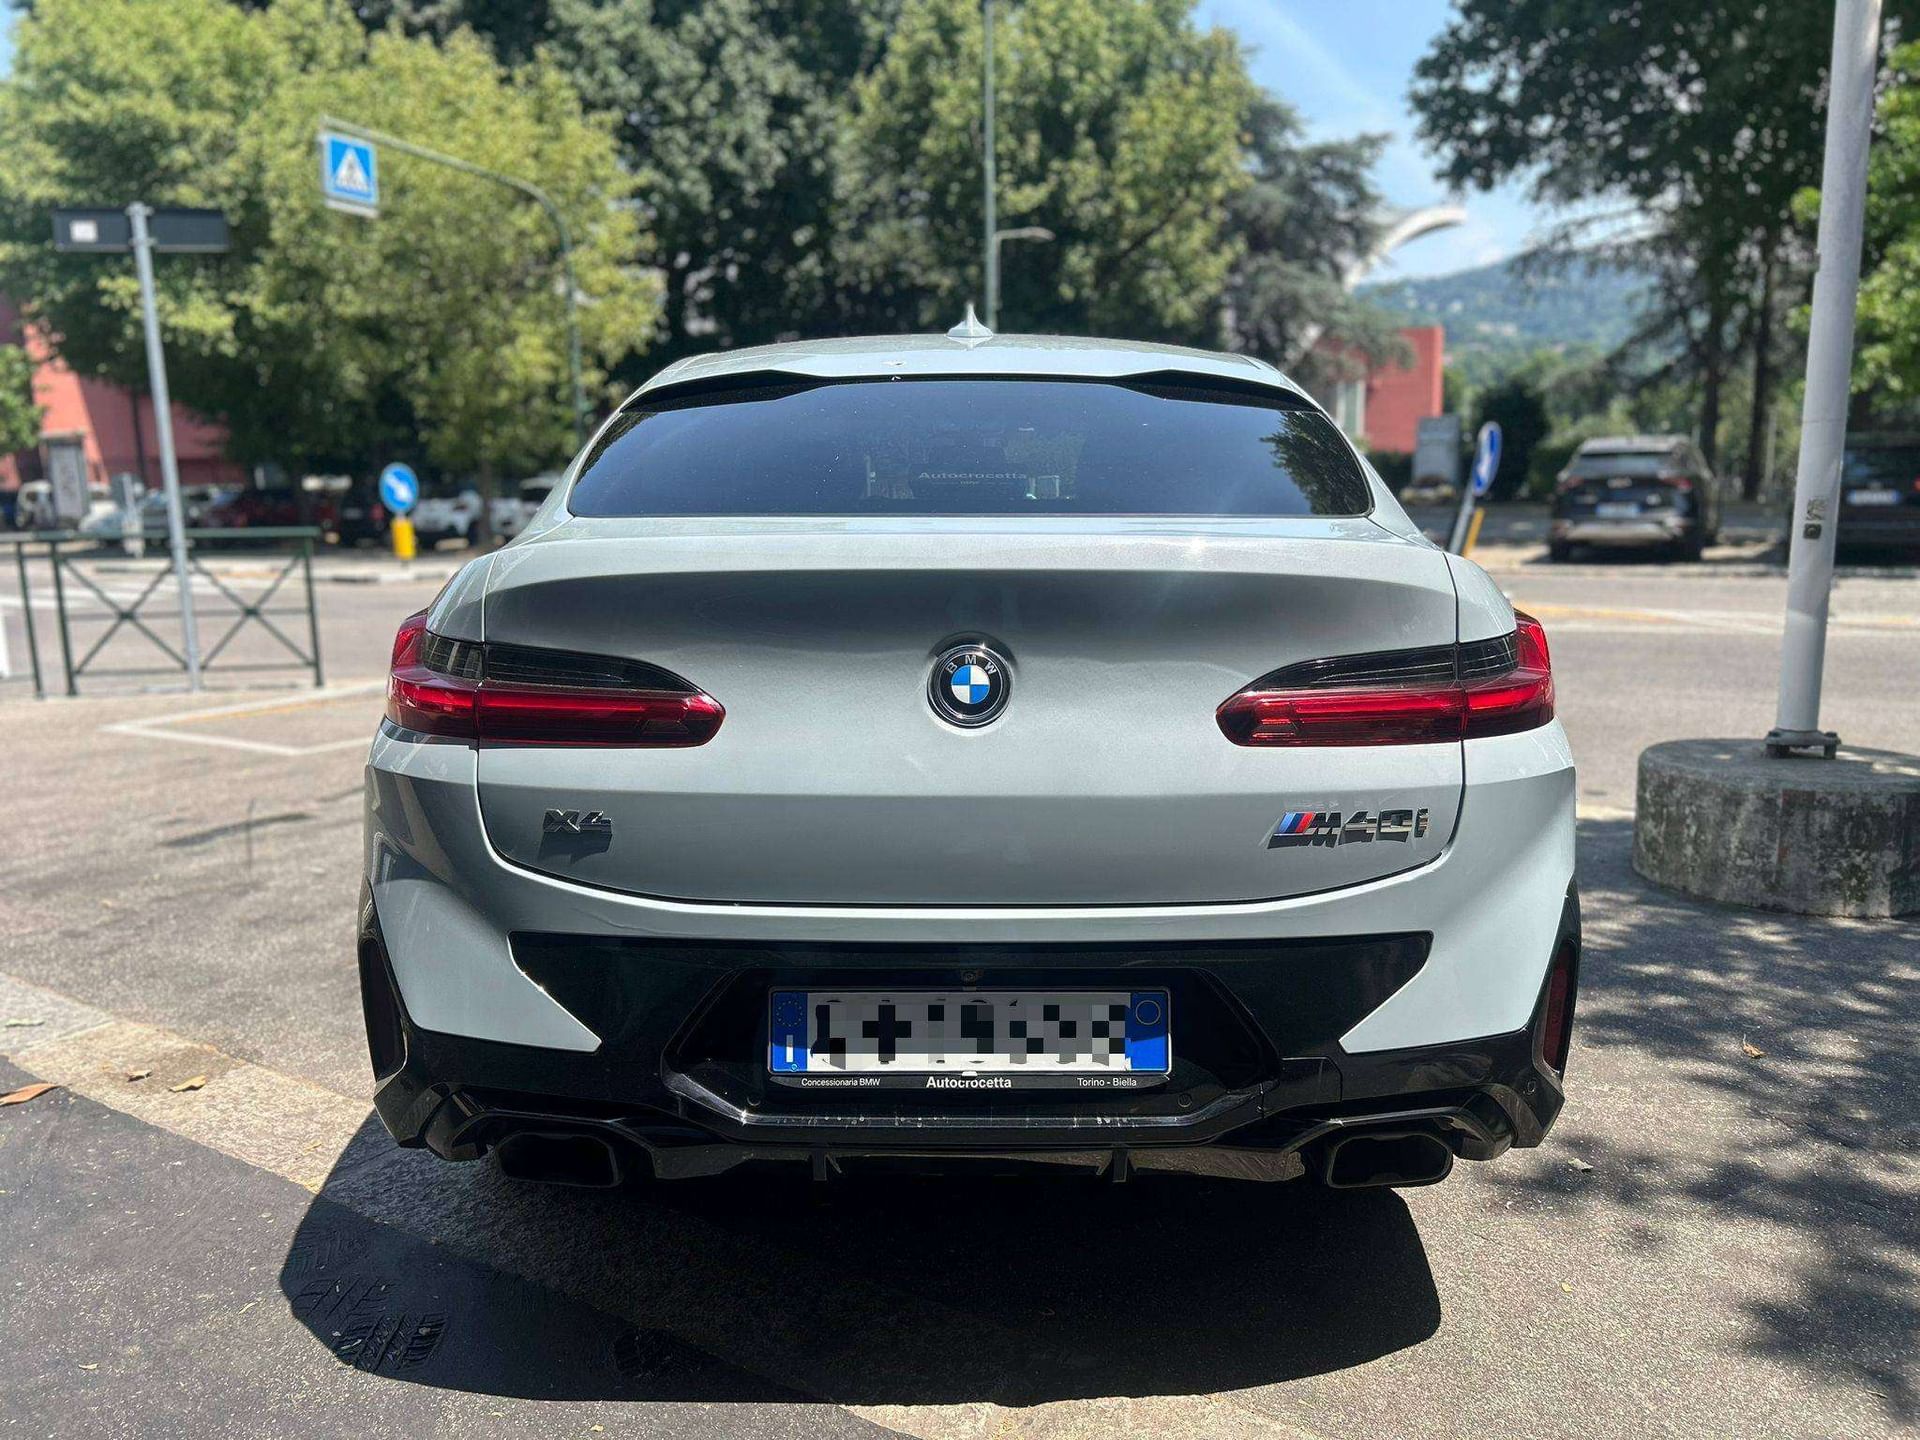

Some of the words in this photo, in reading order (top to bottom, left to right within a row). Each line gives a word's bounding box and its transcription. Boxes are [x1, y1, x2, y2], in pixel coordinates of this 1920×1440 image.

[945, 654, 997, 675] BMW
[543, 808, 612, 833] X4
[801, 1077, 858, 1087] Concessionaria
[859, 1077, 881, 1087] BMW
[926, 1076, 1012, 1089] Autocrocetta
[1076, 1077, 1105, 1087] Torino
[1112, 1077, 1137, 1087] Biella
